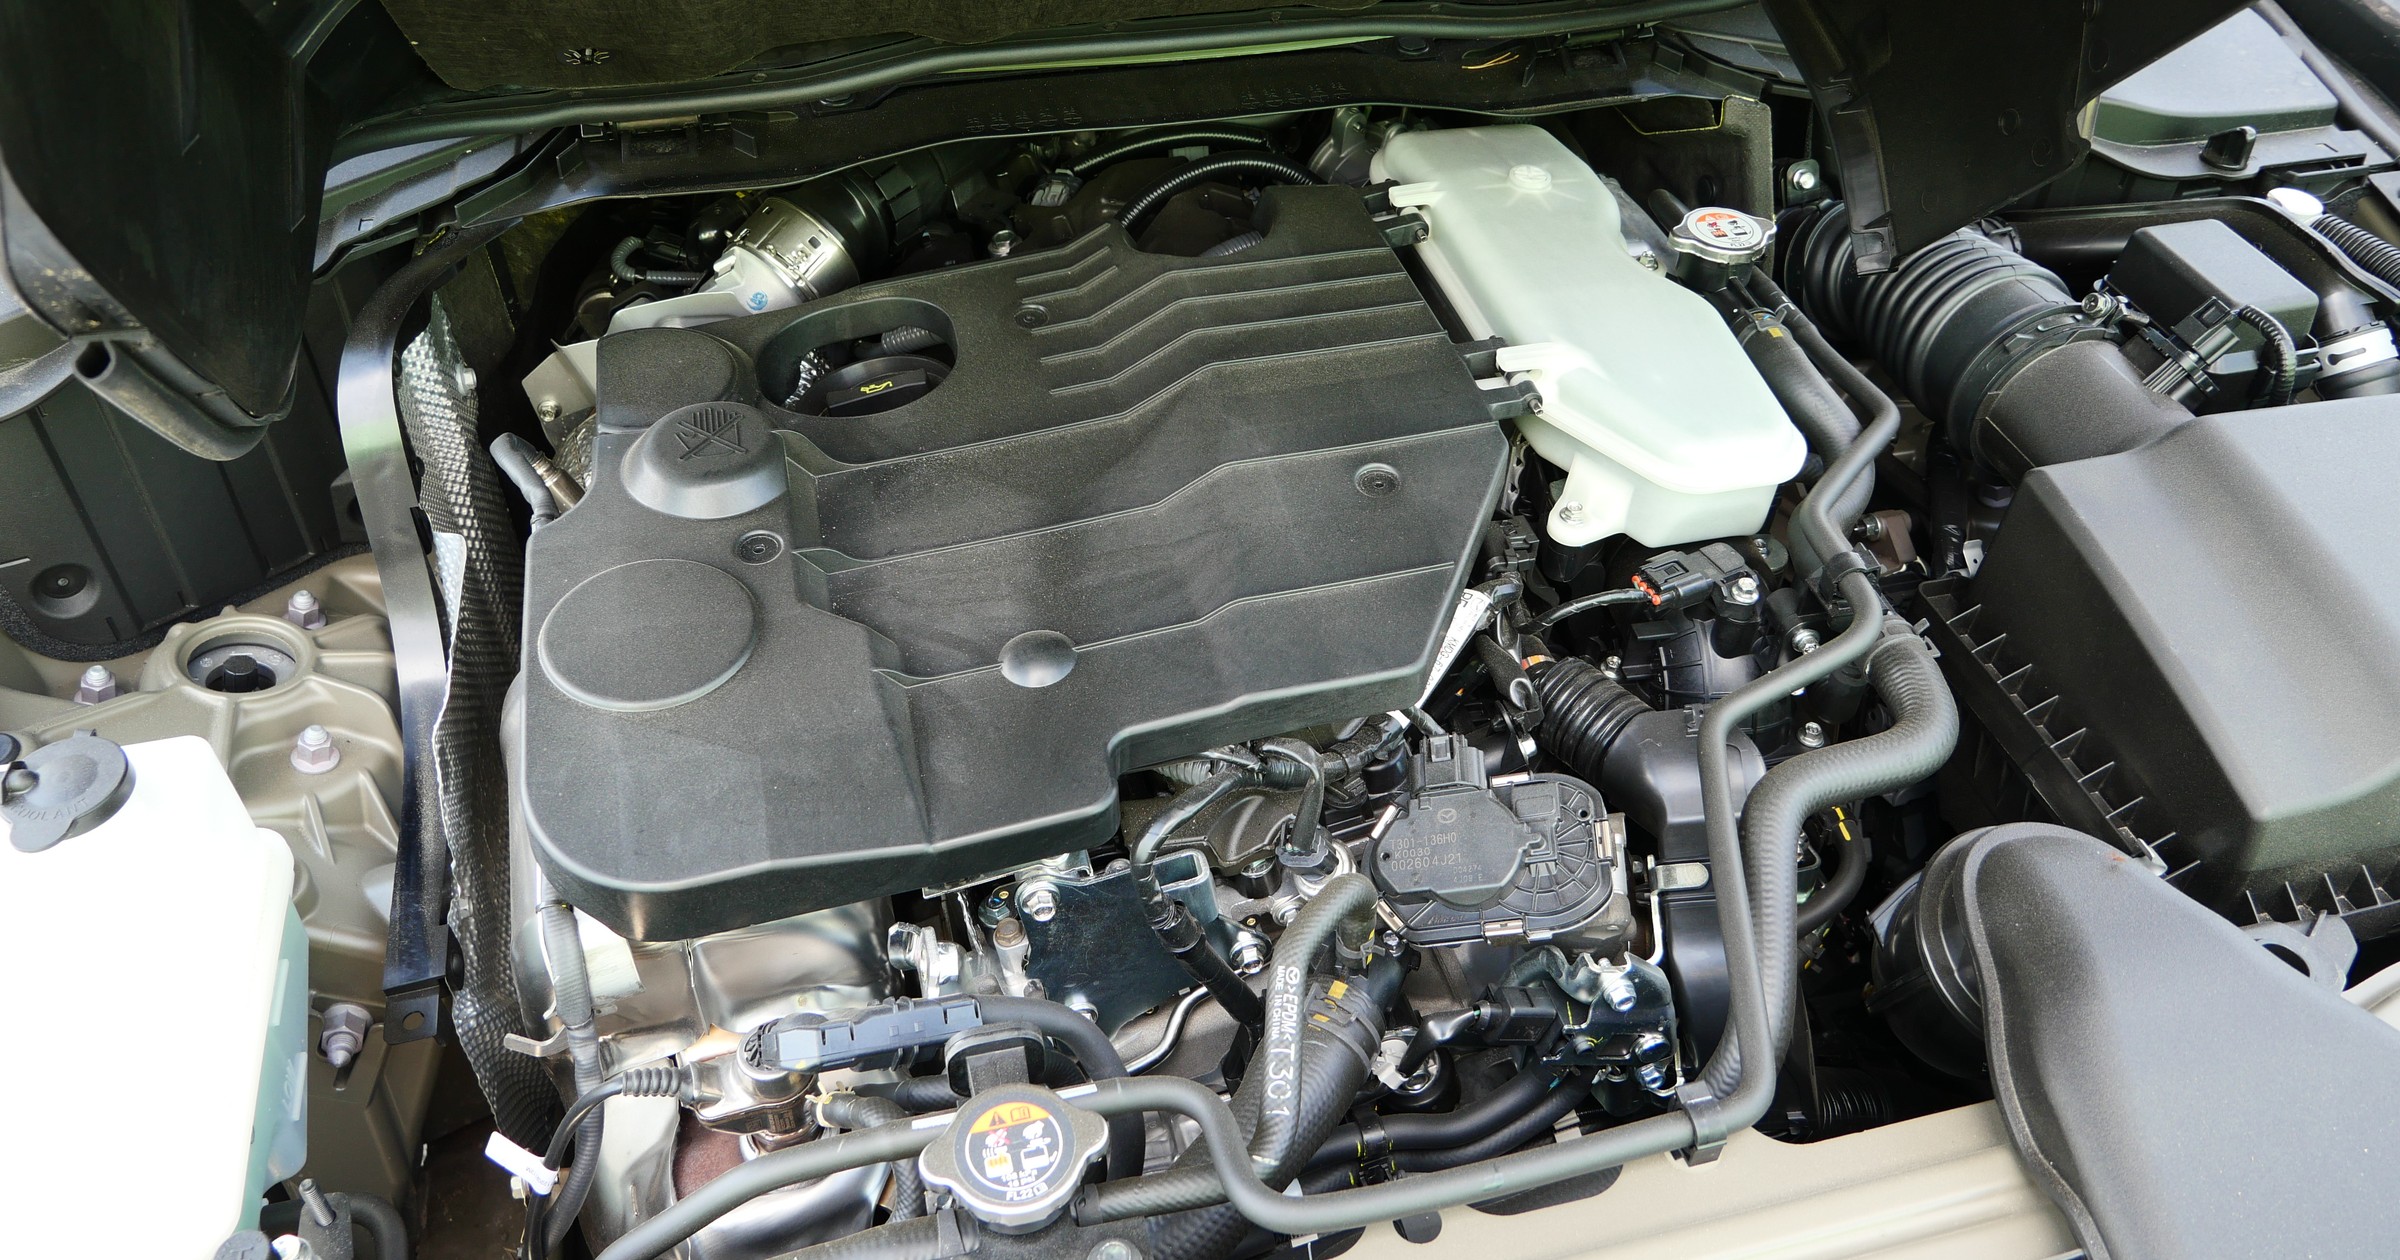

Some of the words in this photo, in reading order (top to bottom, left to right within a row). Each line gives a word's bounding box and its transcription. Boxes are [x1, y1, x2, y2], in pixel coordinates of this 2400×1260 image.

[10, 797, 88, 821] COOLANT
[1391, 831, 1457, 851] T301-136H0
[1391, 852, 1461, 872] 002604J21
[1394, 846, 1431, 860] K0030
[1275, 965, 1286, 991] MADE
[1273, 994, 1283, 1007] IN
[1270, 1007, 1281, 1040] CHINA
[1006, 1188, 1034, 1201] FL22
